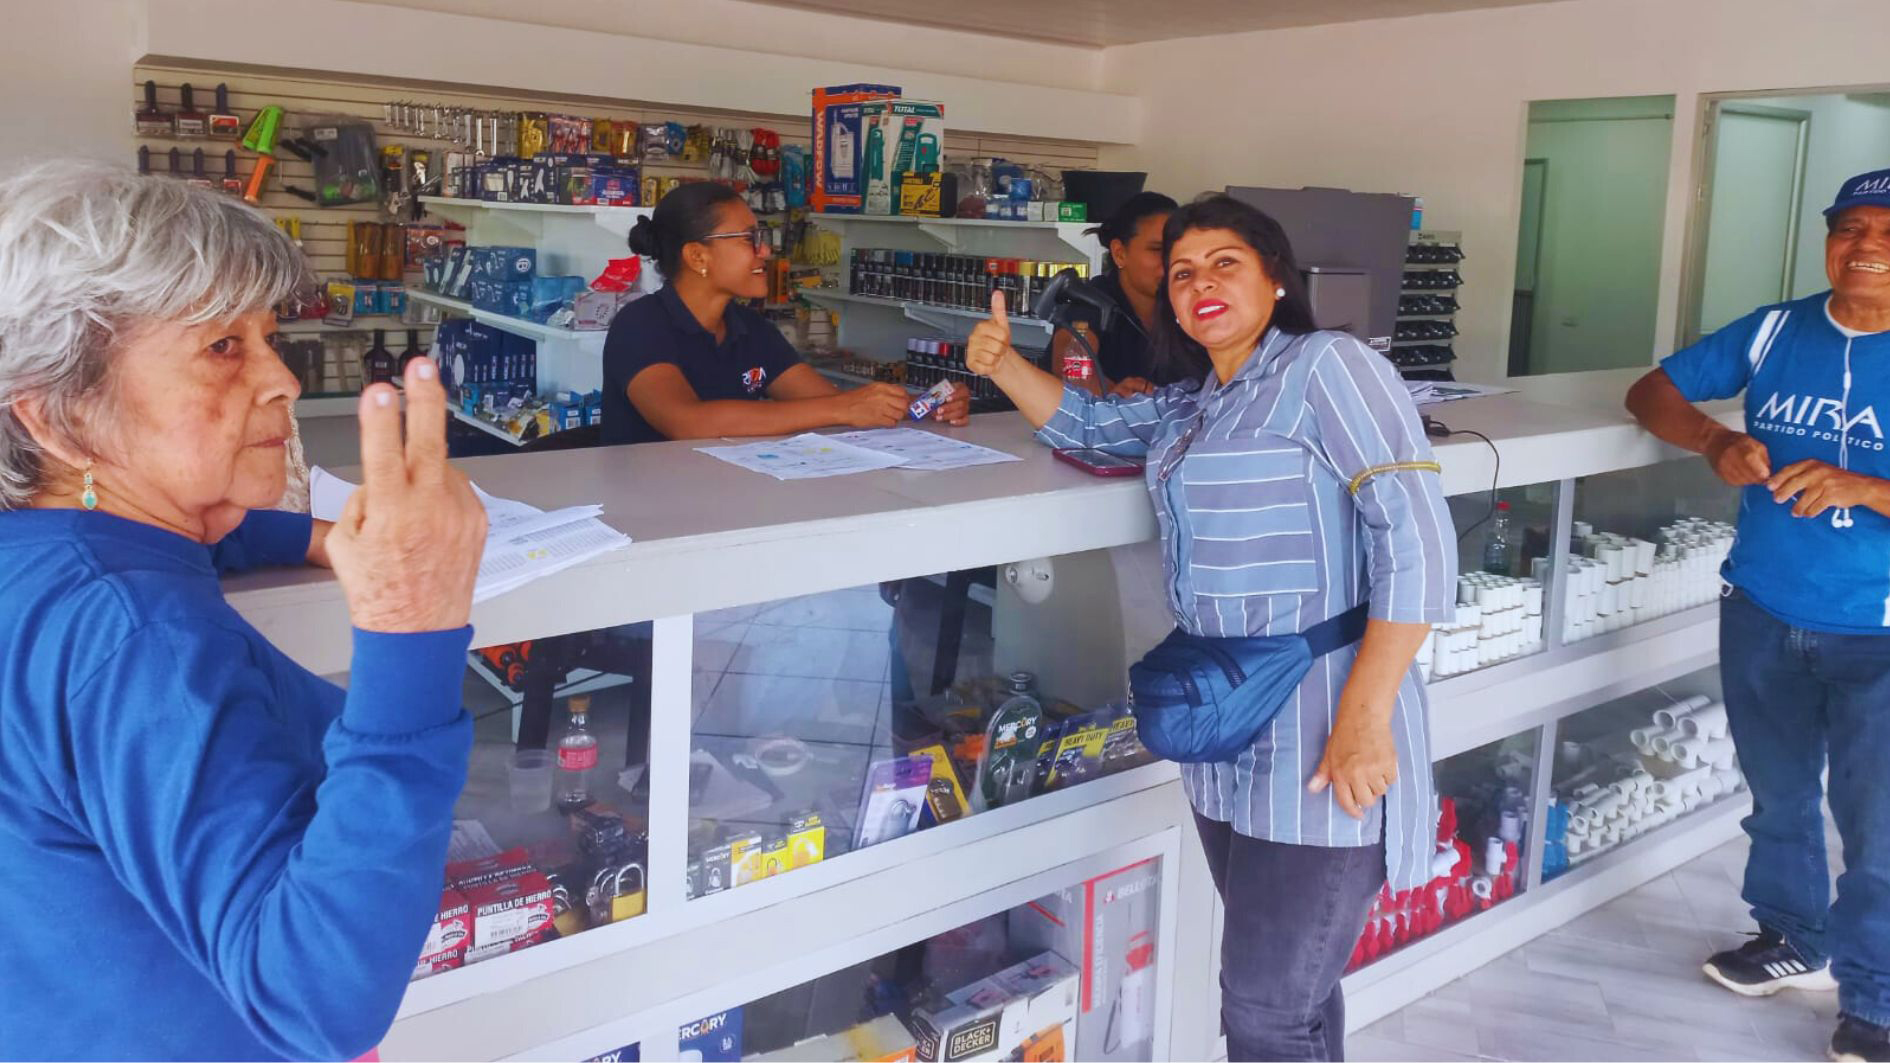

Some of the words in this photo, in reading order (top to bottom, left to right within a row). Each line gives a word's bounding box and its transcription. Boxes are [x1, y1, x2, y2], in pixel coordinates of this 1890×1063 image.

[894, 104, 915, 113] TOTAL
[1756, 391, 1884, 439] MIRA
[1753, 420, 1806, 436] PARTIDO
[1812, 430, 1884, 451] POLTICO
[441, 904, 469, 920] HIERRO
[477, 900, 513, 916] PUNTILLA
[514, 896, 524, 906] DE
[525, 889, 552, 905] HIERRO
[953, 1034, 991, 1054] DECKER
